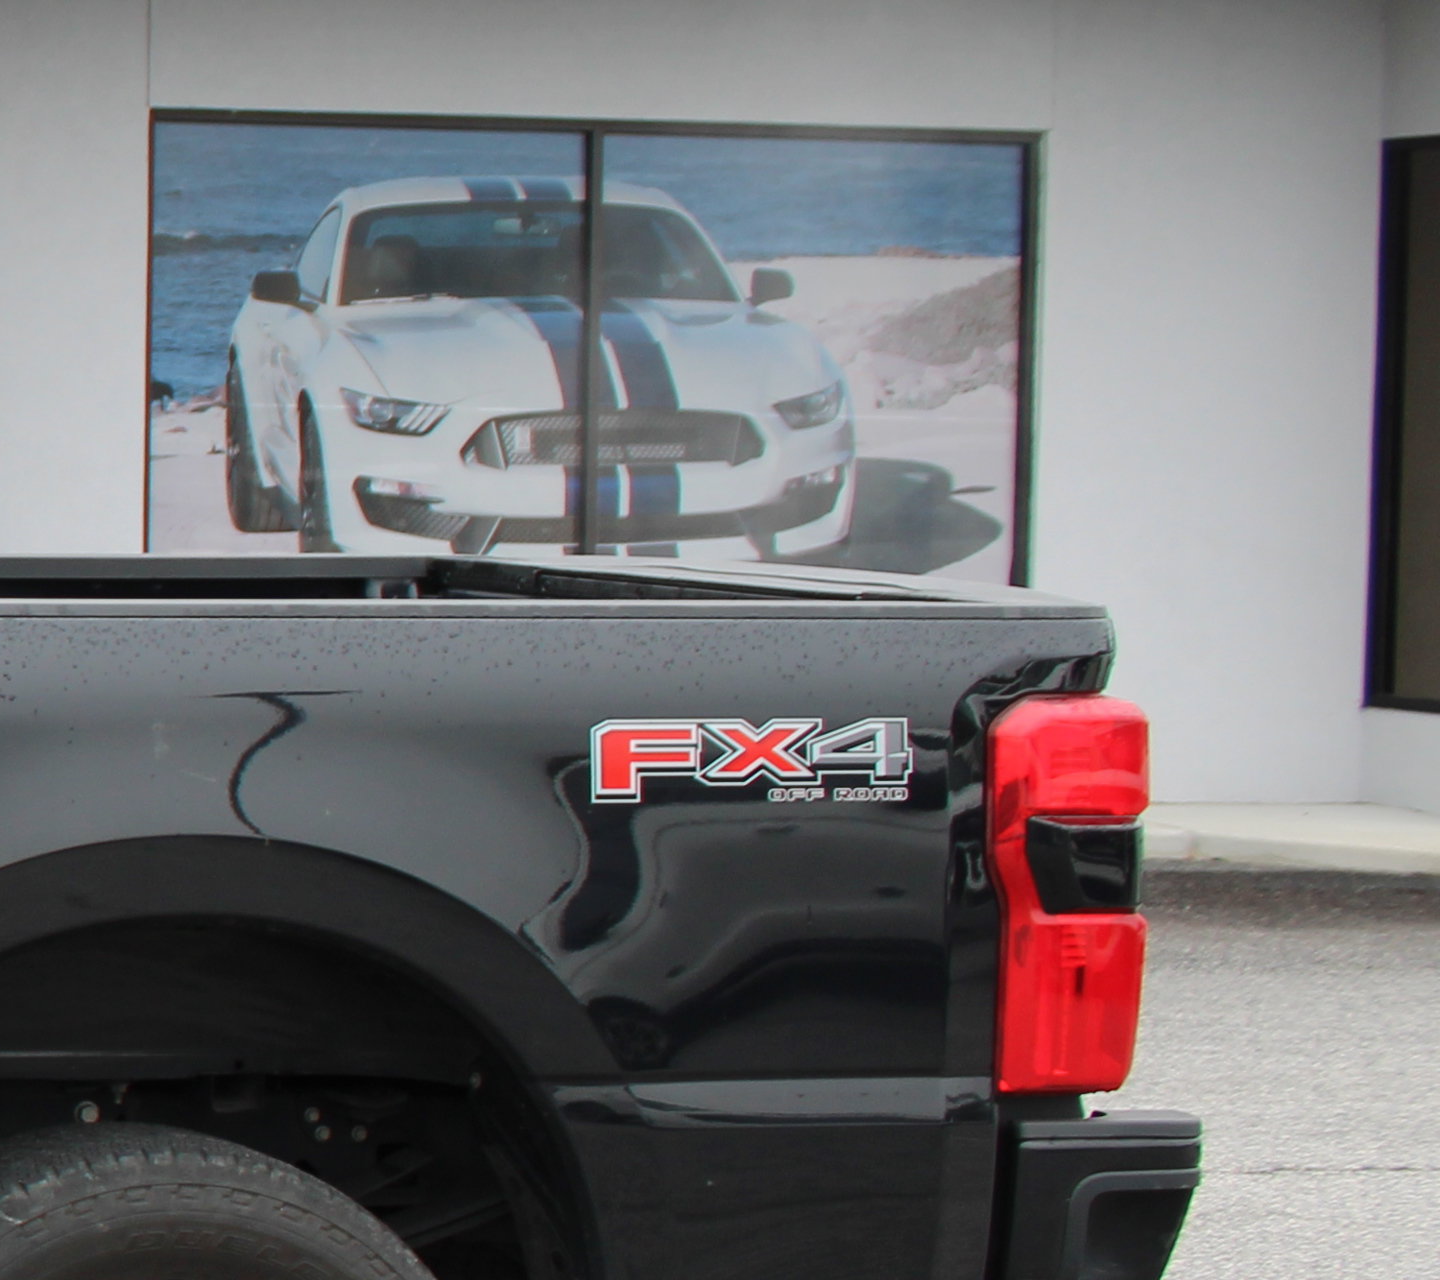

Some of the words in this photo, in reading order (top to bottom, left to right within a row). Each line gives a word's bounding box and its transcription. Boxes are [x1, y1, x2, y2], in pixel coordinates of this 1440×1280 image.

[590, 717, 912, 803] FX4
[767, 787, 825, 802] OFF
[833, 786, 909, 802] ROAD
